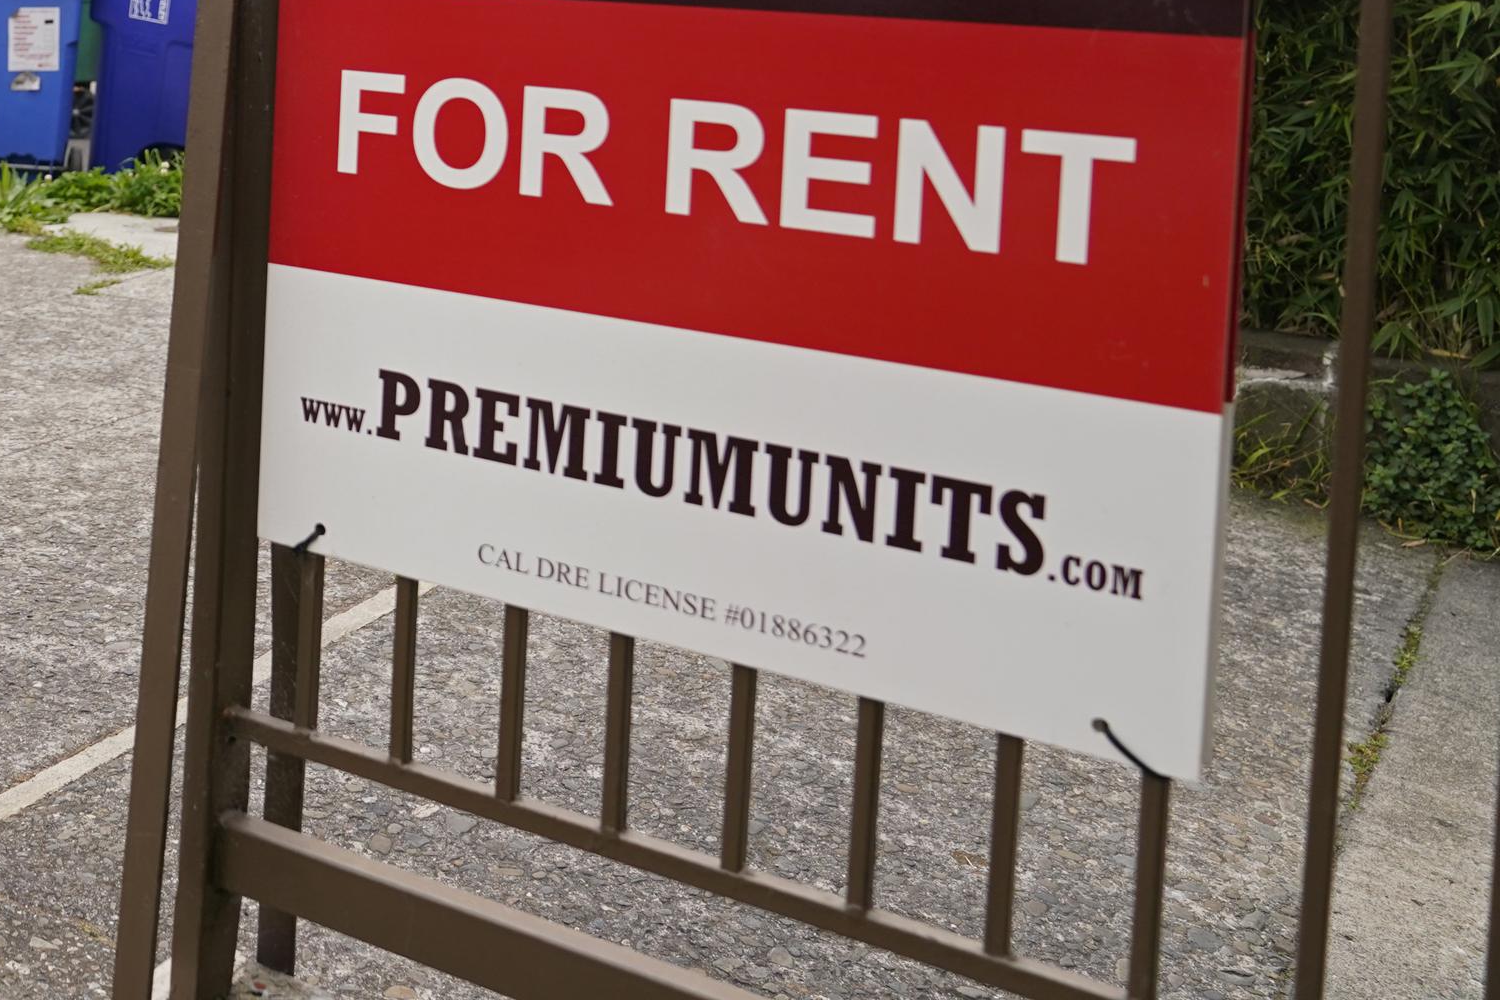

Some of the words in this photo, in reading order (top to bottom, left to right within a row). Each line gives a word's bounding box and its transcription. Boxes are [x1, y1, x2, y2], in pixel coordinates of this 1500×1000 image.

[336, 69, 614, 207] FOR
[664, 98, 1138, 266] RENT
[477, 542, 530, 576] CAL
[536, 556, 591, 590] DRE
[597, 571, 717, 622] LICENSE
[724, 604, 868, 659] #01886322
